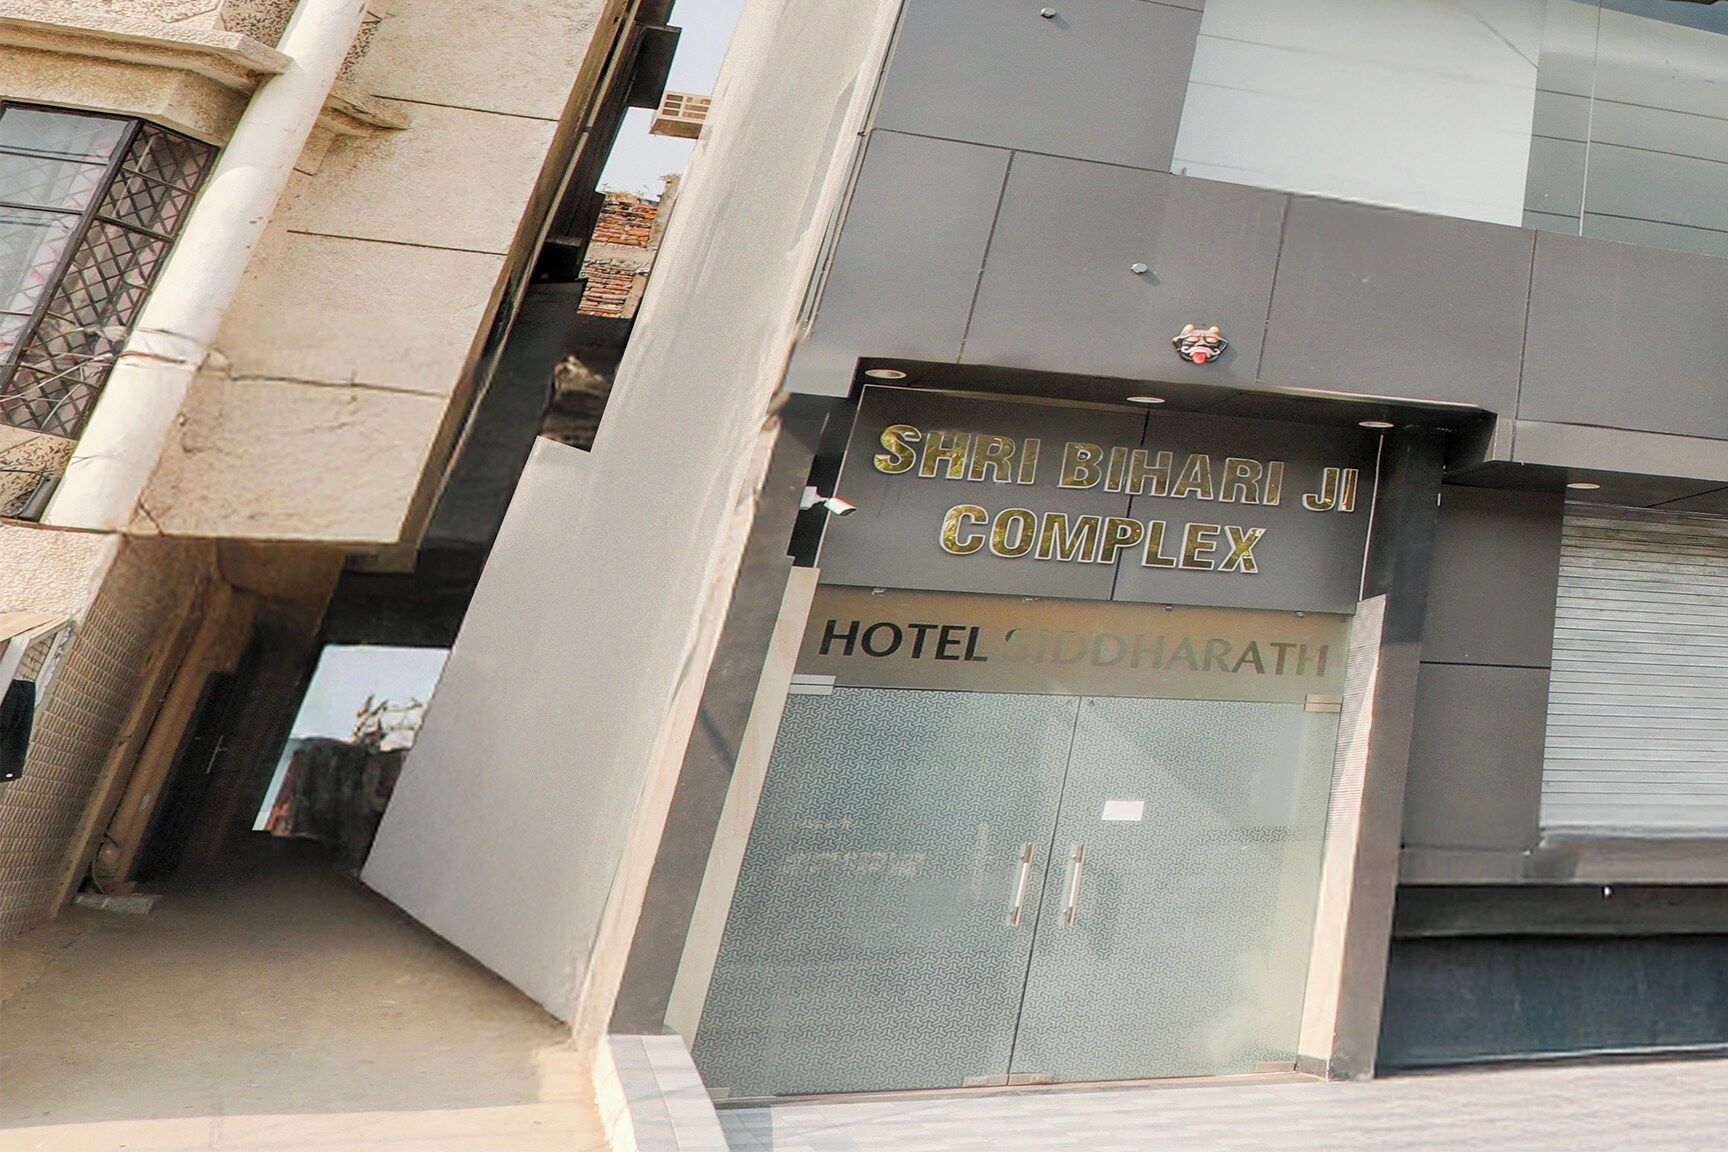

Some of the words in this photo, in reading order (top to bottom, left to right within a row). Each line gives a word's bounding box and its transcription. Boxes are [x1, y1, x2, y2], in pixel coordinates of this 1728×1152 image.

[872, 423, 1042, 486] SHRI
[1056, 440, 1285, 507] BIHARI
[1300, 466, 1359, 513] JI
[938, 503, 1268, 574] COMPLEX
[818, 618, 989, 662] HOTEL
